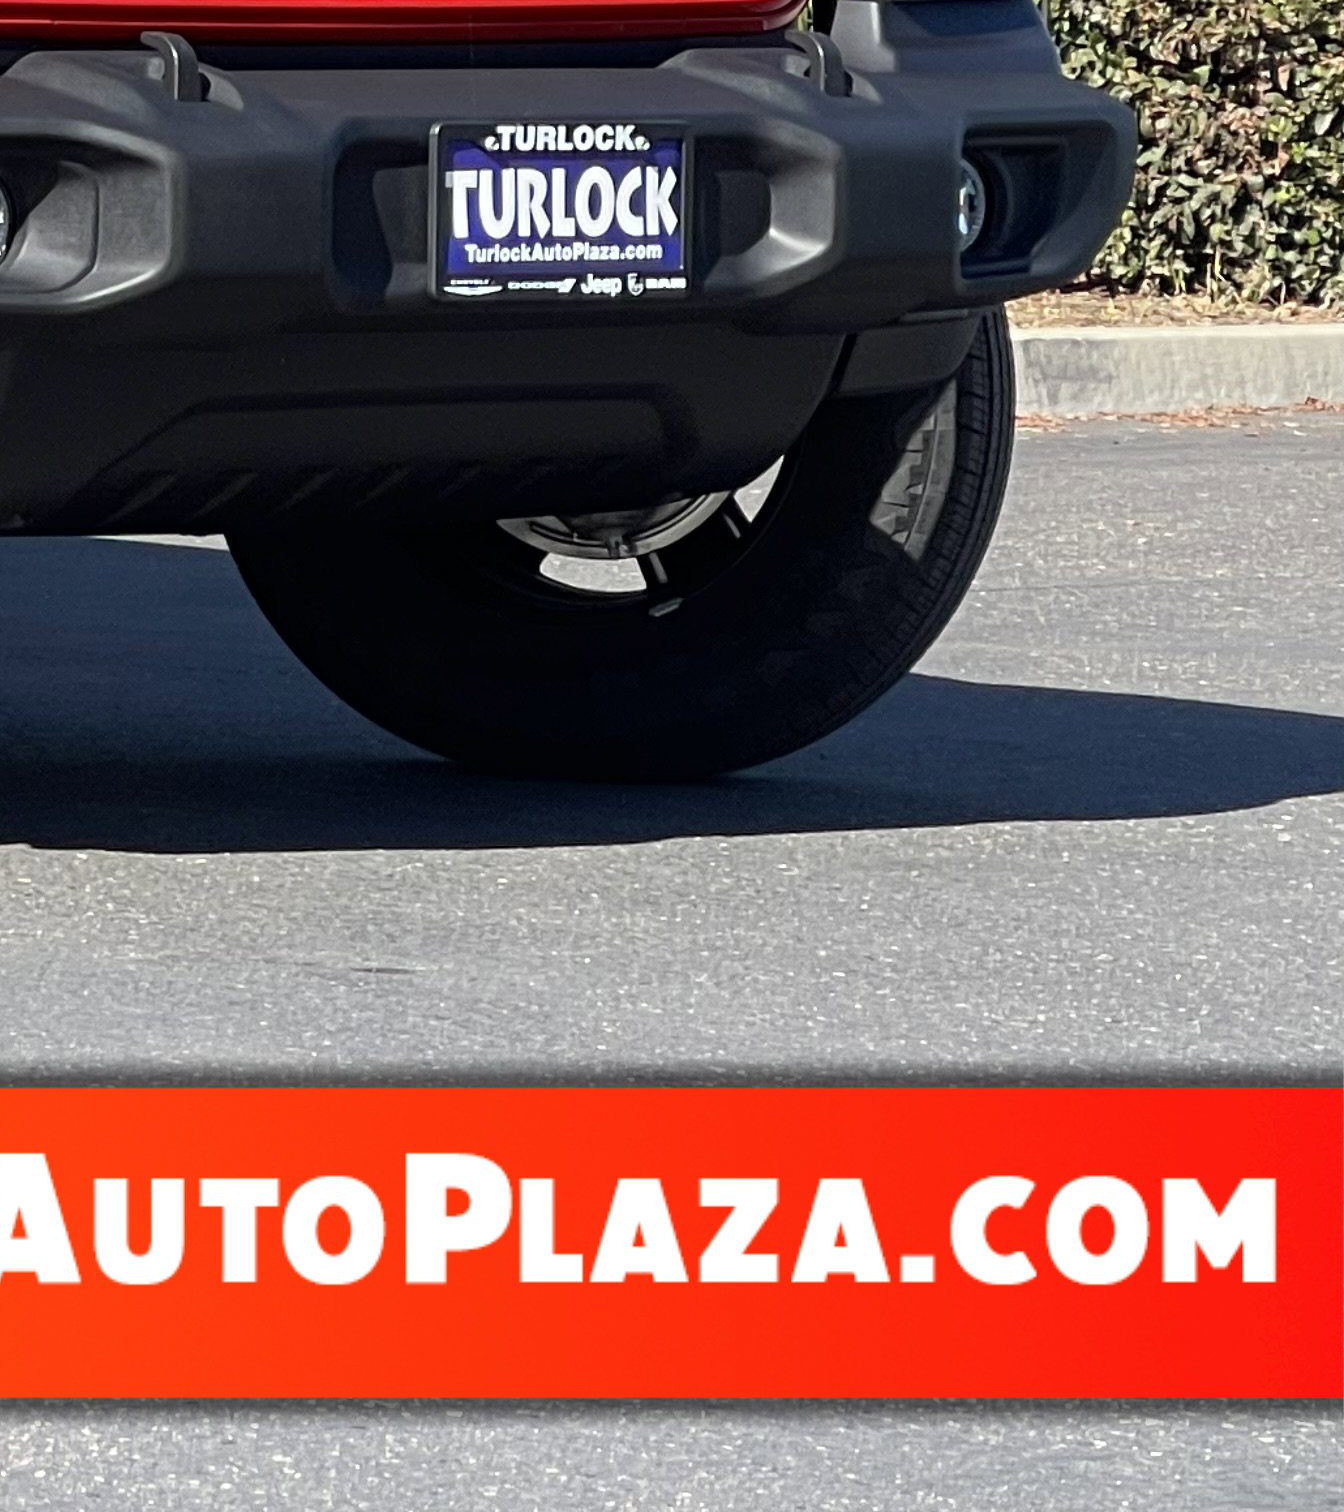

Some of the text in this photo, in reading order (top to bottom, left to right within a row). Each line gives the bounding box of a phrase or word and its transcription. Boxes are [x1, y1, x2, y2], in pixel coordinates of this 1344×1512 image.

[496, 124, 635, 151] TURLOCK
[445, 166, 679, 239] TURLOCK
[464, 243, 663, 264] TurlockAutoPlaza.com
[581, 273, 622, 297] Jeep
